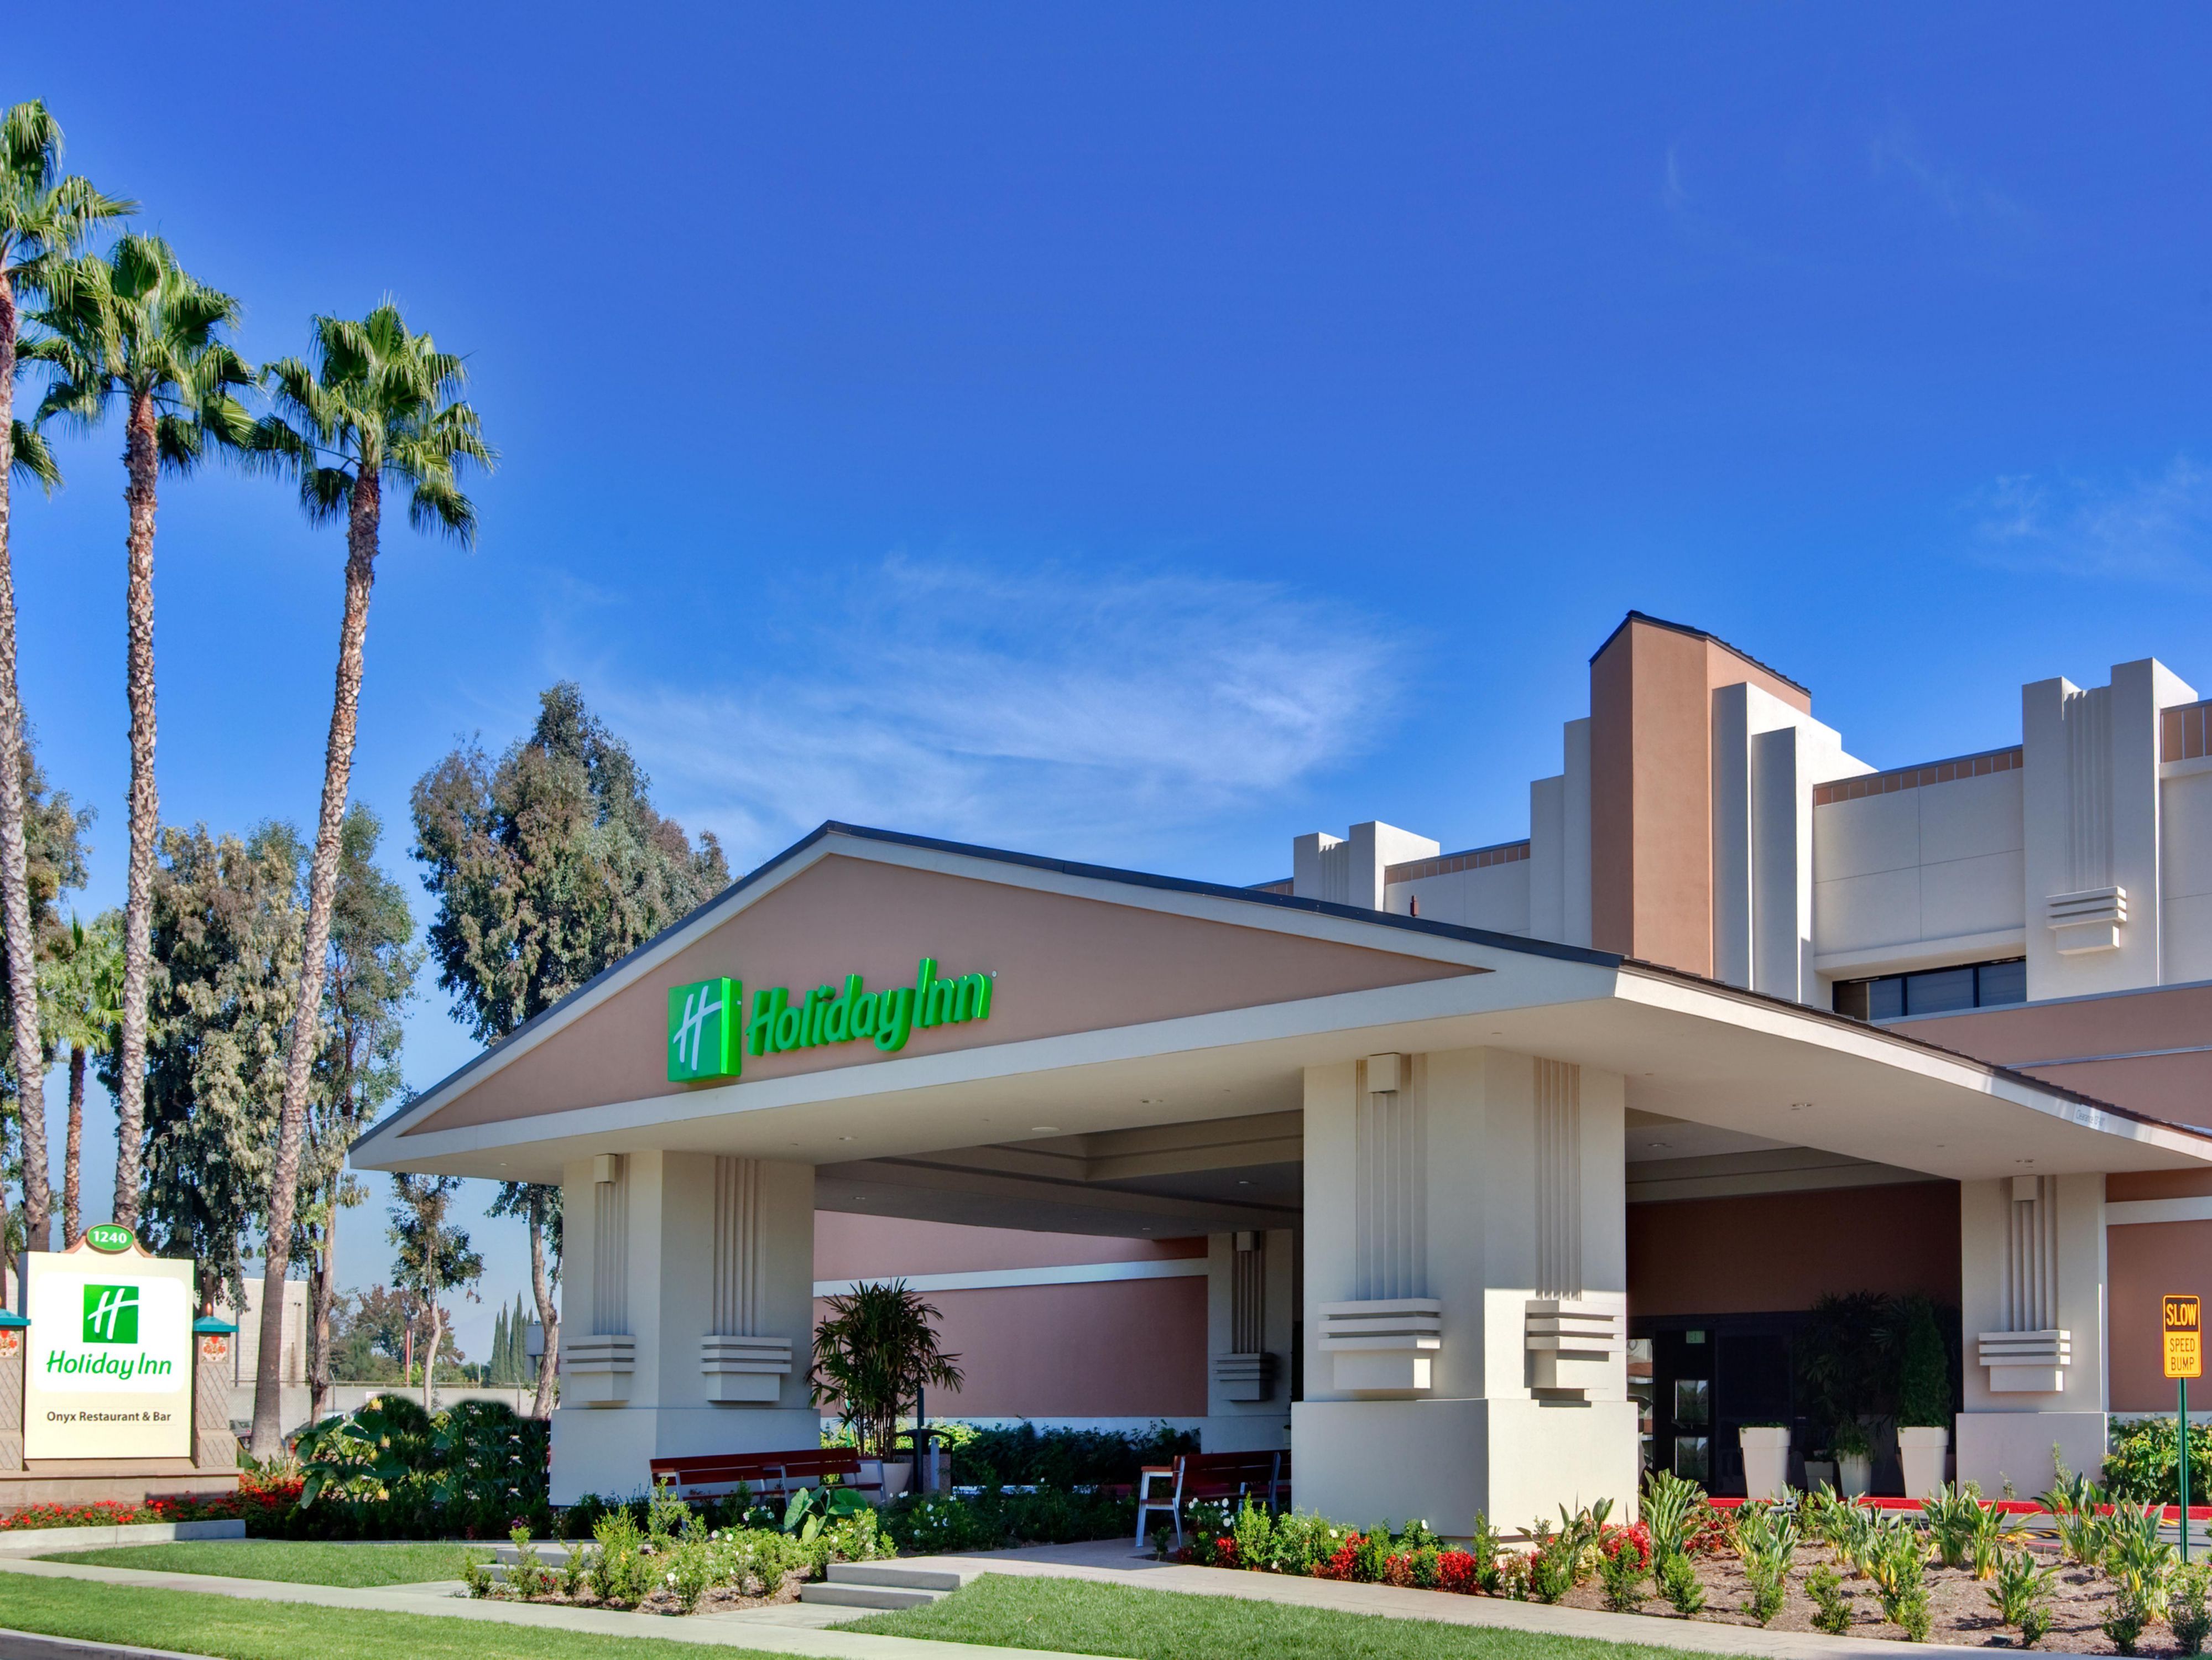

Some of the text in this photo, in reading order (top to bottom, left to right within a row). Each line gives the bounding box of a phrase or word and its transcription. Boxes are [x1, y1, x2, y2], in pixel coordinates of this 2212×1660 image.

[745, 958, 993, 1056] Holiday Inn
[93, 1231, 127, 1243] 1240
[2166, 1303, 2197, 1326] SLOW
[2170, 1338, 2195, 1352] SPEED
[46, 1350, 172, 1380] Holiday Inn
[2171, 1357, 2194, 1371] BUMP
[47, 1412, 171, 1424] Onyx Restaurant & Bar
